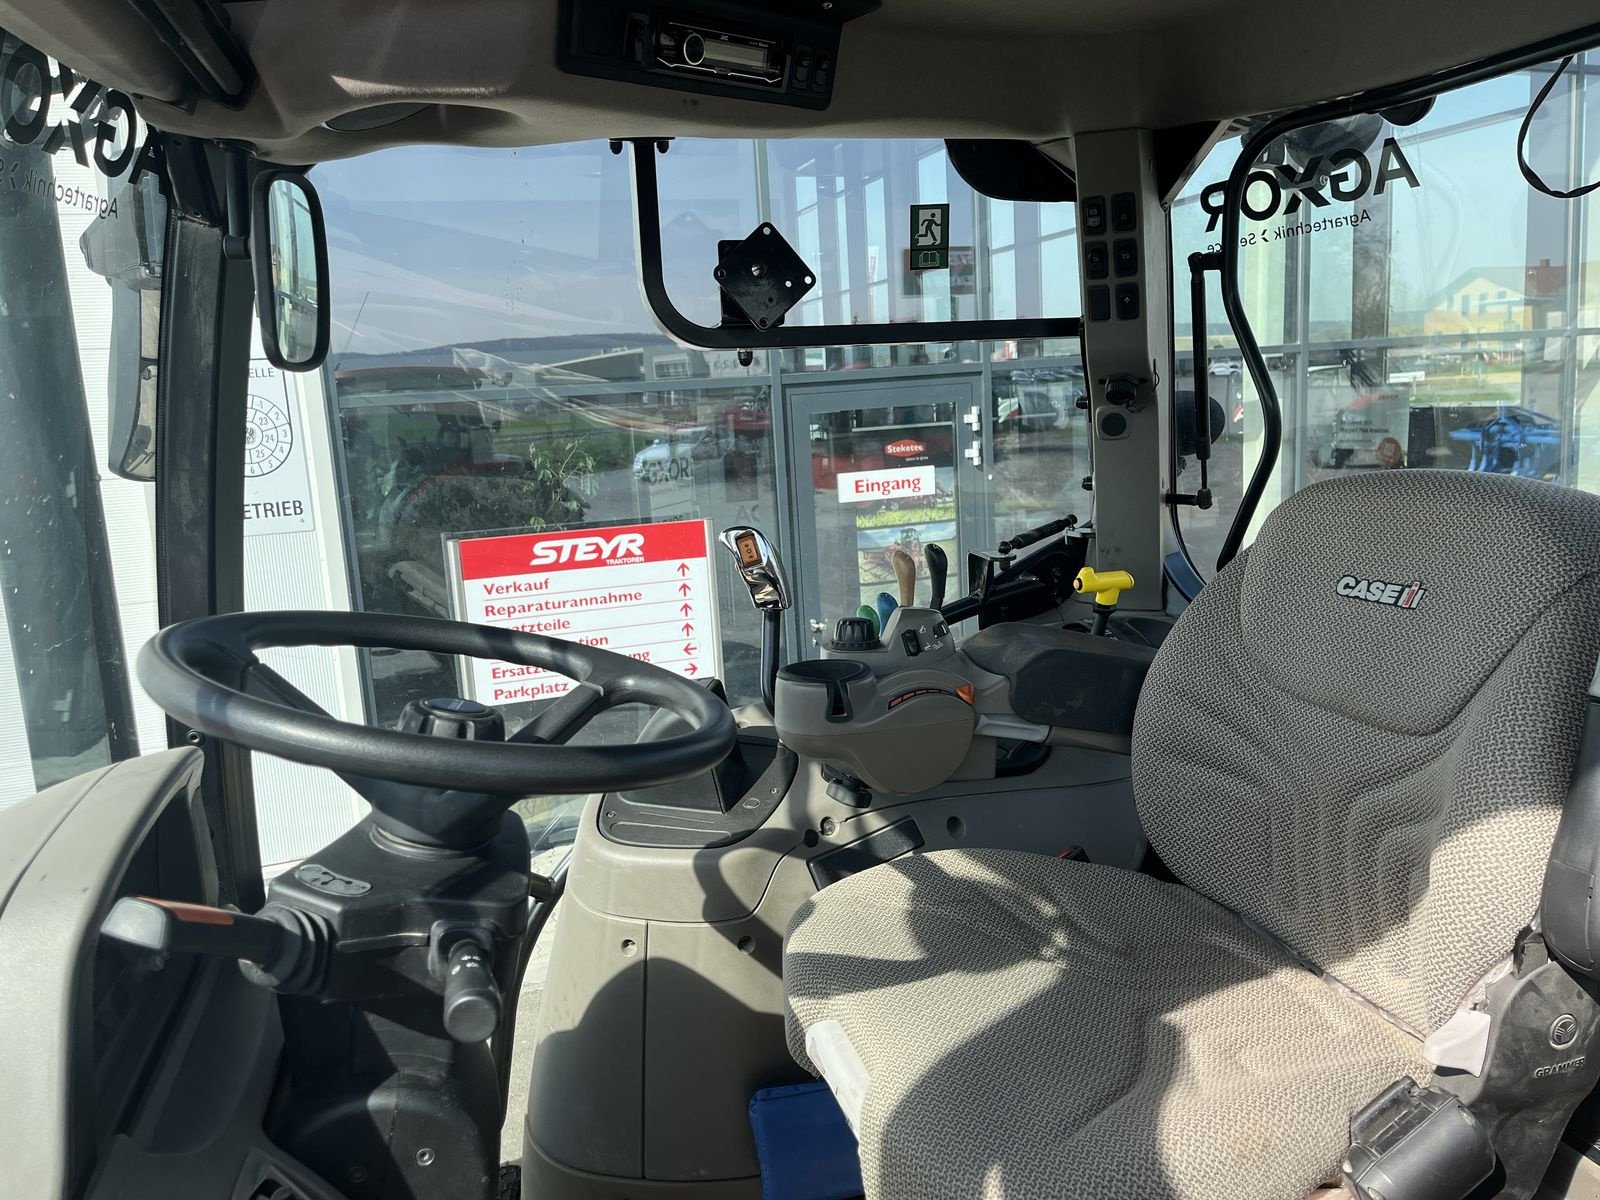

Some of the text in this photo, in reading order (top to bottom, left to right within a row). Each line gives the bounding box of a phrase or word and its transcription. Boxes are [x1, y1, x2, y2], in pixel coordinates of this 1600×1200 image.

[264, 434, 275, 443] 24
[854, 477, 921, 495] Eingang
[244, 500, 304, 519] ETRIEB
[529, 533, 645, 566] STEYR
[605, 556, 645, 565] TRAKTOREN
[483, 578, 550, 595] Verkauf
[1336, 575, 1402, 604] CASE
[484, 590, 643, 618] Reparaturannahme
[494, 681, 570, 701] Parkplatz
[1535, 1055, 1586, 1079] GRAMMER
